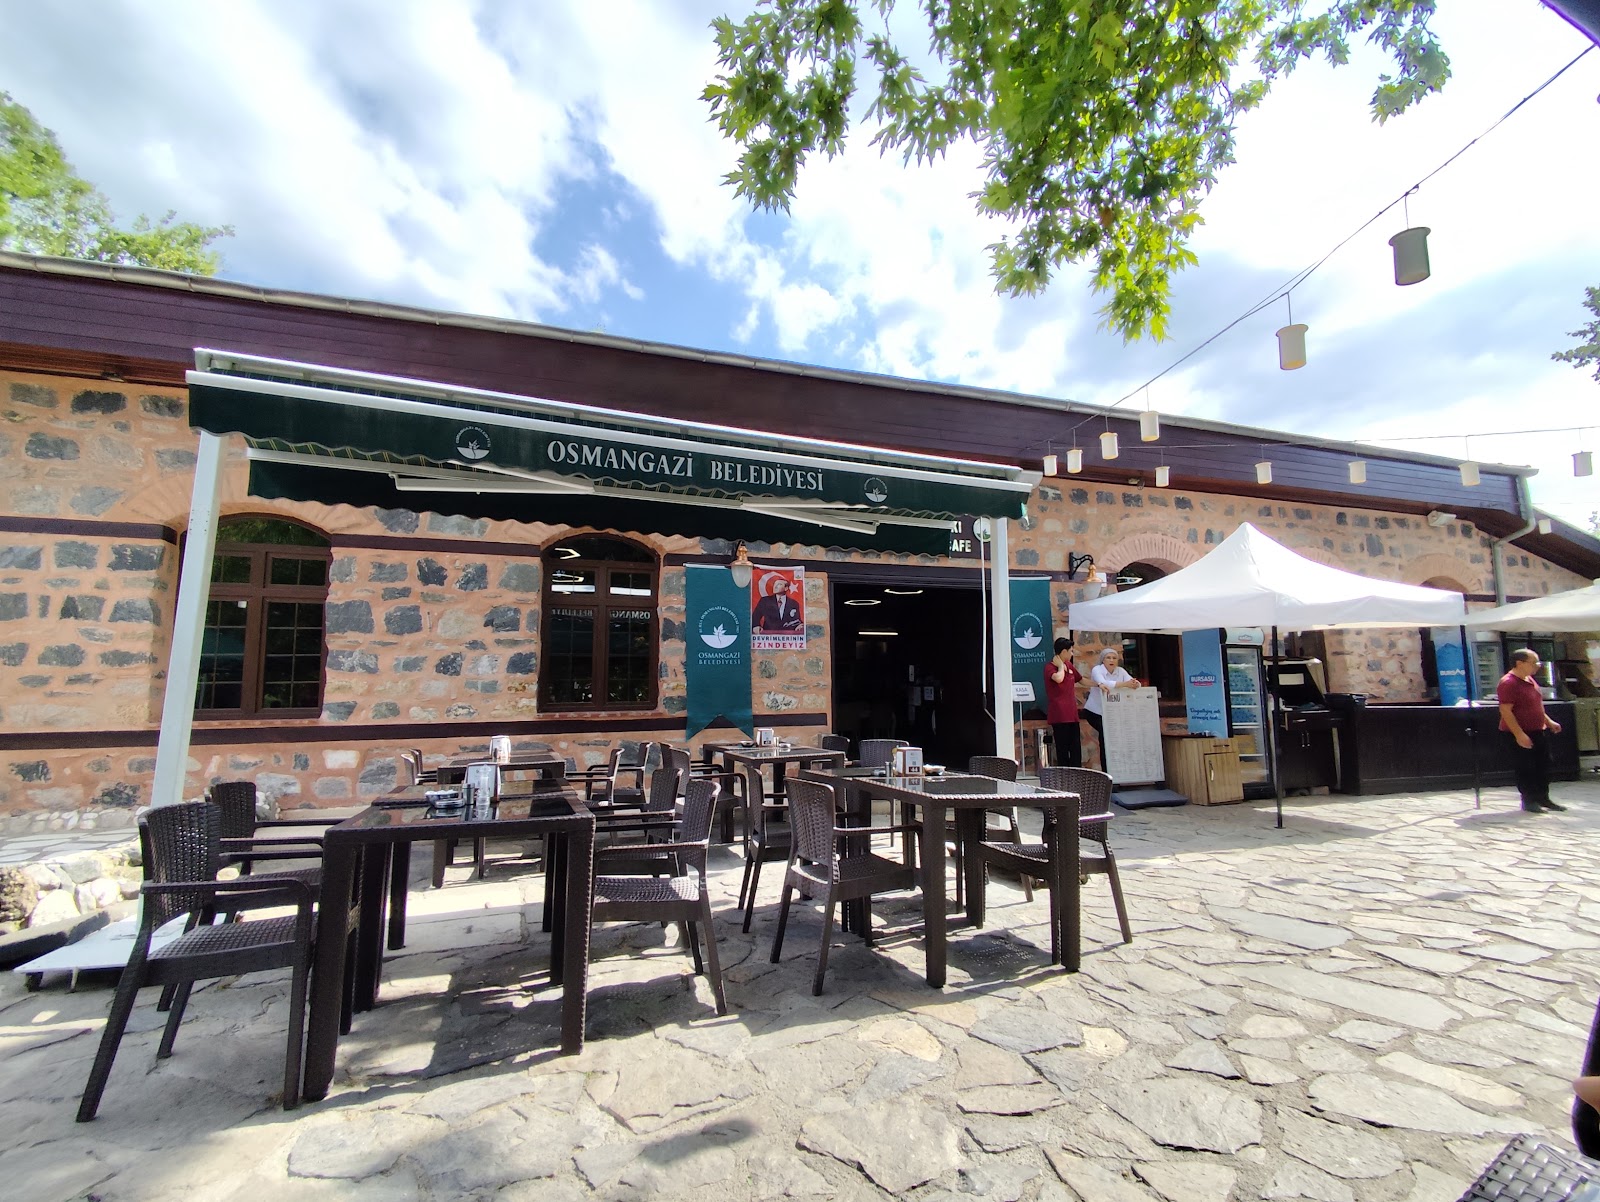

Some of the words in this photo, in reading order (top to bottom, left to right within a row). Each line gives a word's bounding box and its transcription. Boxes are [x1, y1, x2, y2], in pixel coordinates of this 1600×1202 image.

[547, 440, 693, 477] OSMANGAZİ
[710, 460, 824, 491] BELEDİYESİ
[949, 539, 972, 552] AFE
